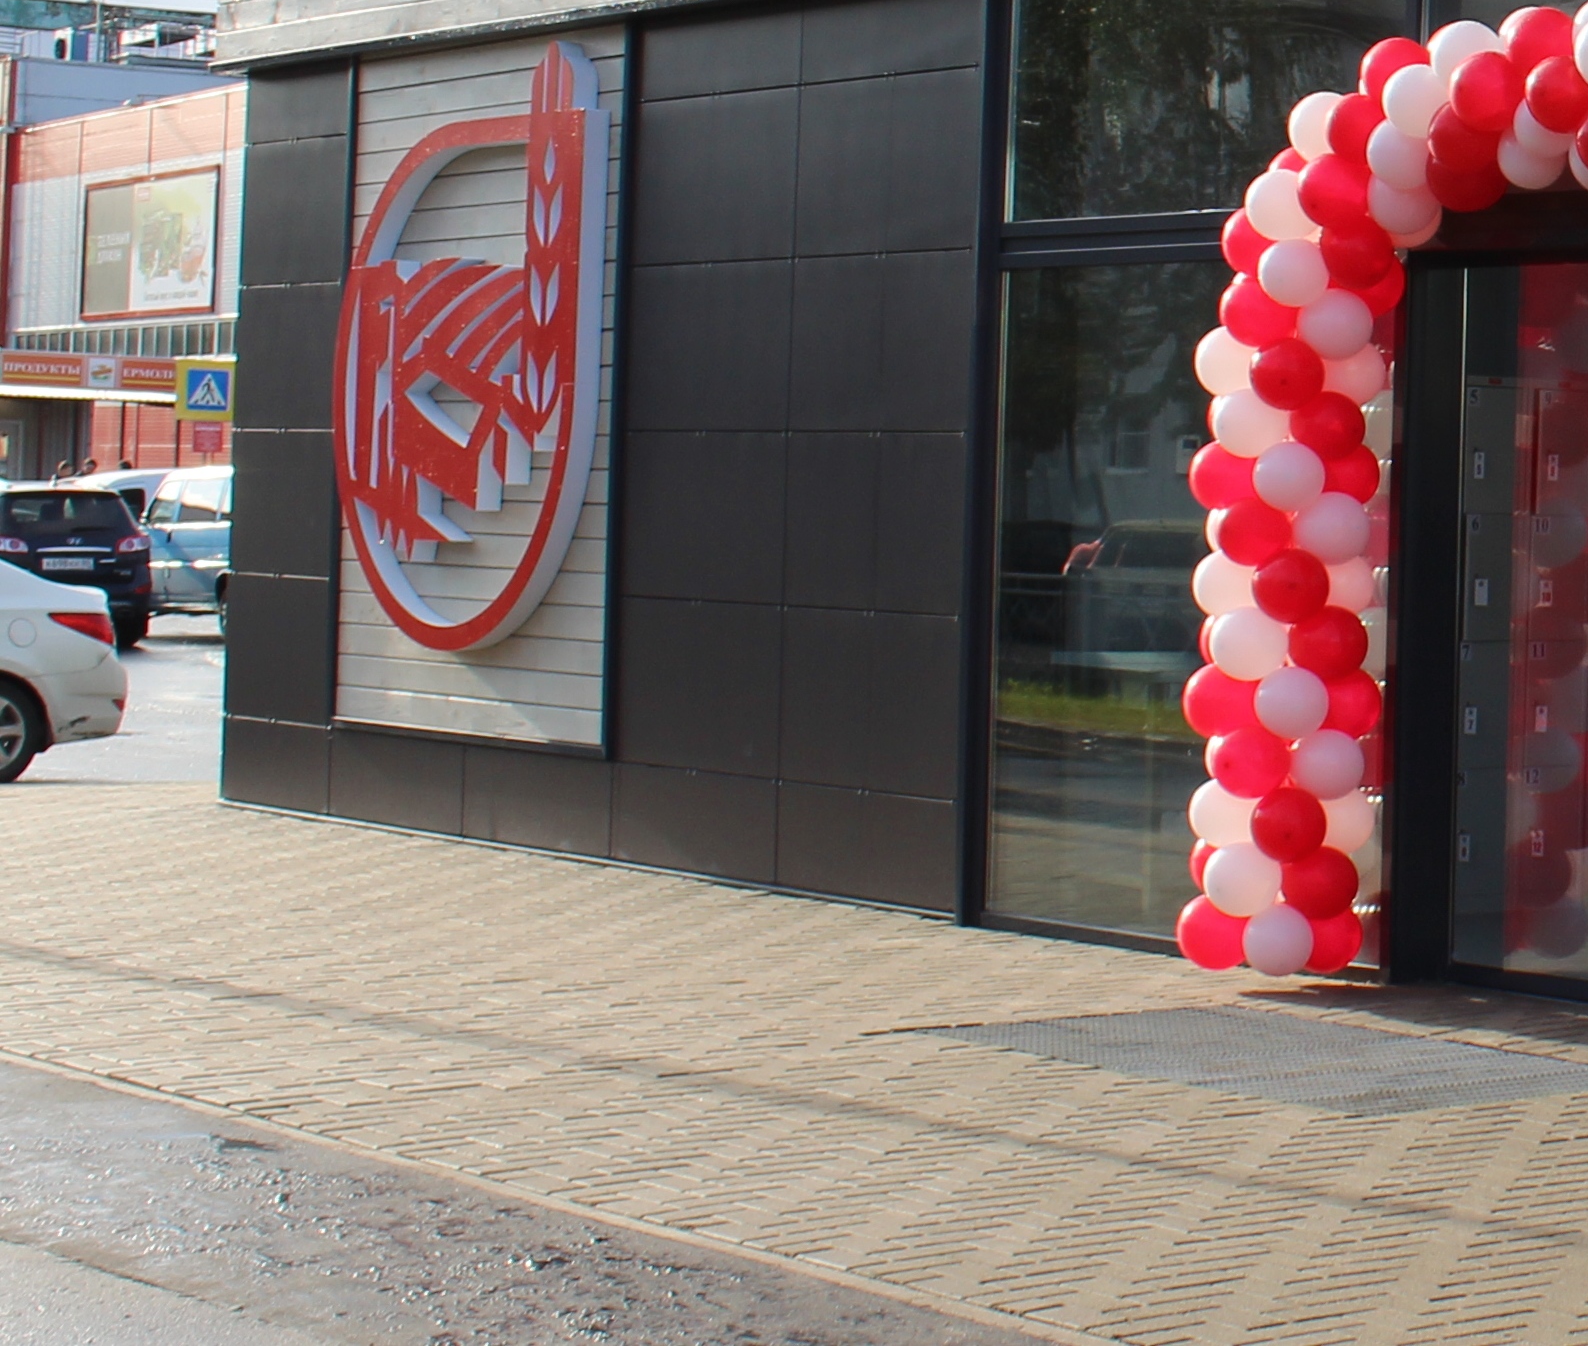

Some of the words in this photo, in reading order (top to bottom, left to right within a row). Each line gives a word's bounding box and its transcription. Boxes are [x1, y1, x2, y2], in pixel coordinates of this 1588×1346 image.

[3, 362, 81, 375] ПРОДУКТЫ
[1471, 516, 1479, 531] 6
[1535, 516, 1550, 532] 10
[1461, 643, 1470, 659] 7
[1532, 643, 1545, 658] 11
[1525, 769, 1539, 785] 12
